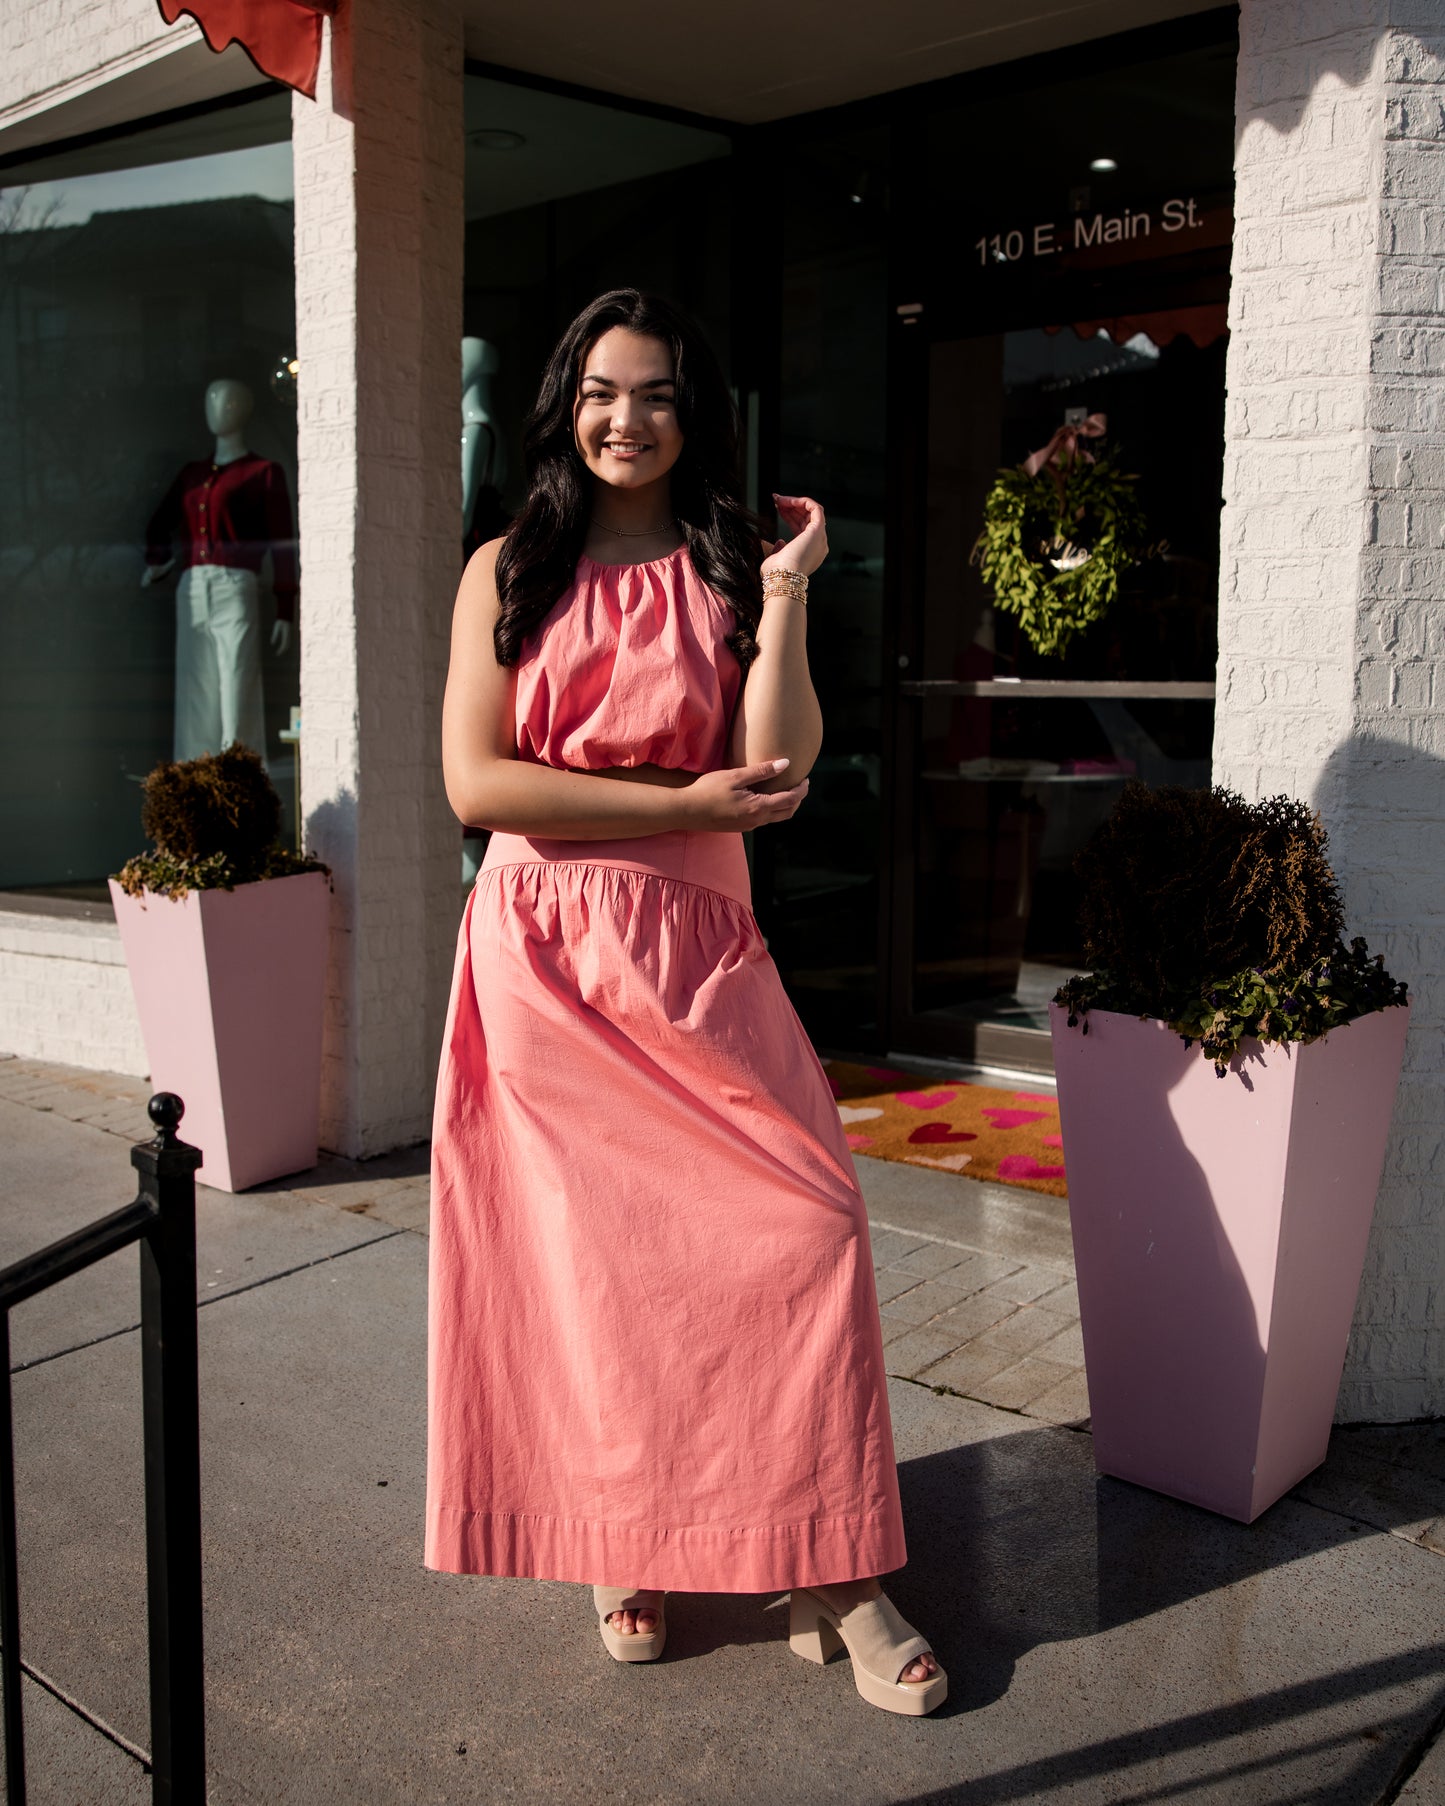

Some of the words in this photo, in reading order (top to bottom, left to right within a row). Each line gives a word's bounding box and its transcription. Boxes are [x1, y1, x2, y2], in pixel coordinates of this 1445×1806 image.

[975, 229, 1025, 267] 110
[1033, 222, 1064, 257] E.
[1074, 207, 1151, 249] Main
[1161, 196, 1204, 232] St.
